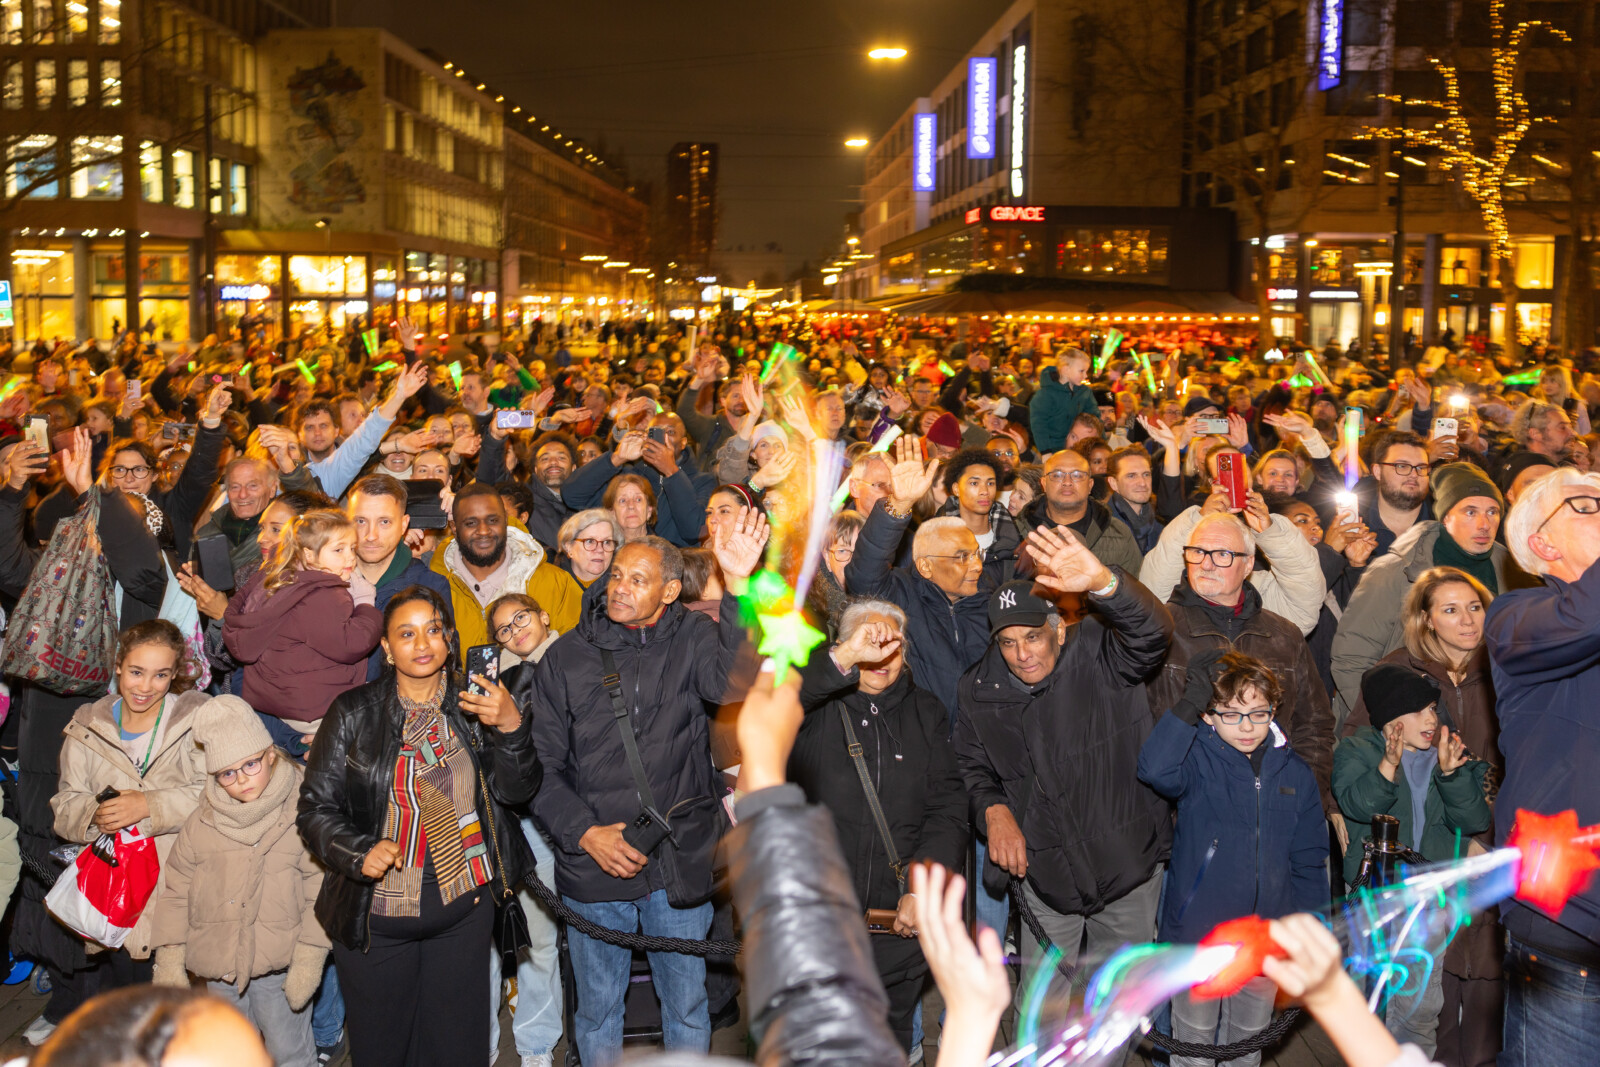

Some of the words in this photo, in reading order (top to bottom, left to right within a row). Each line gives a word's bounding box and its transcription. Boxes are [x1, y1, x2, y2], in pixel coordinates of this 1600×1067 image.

[989, 205, 1046, 221] GRACE
[999, 588, 1017, 610] NY
[37, 643, 109, 682] ZEEMAN
